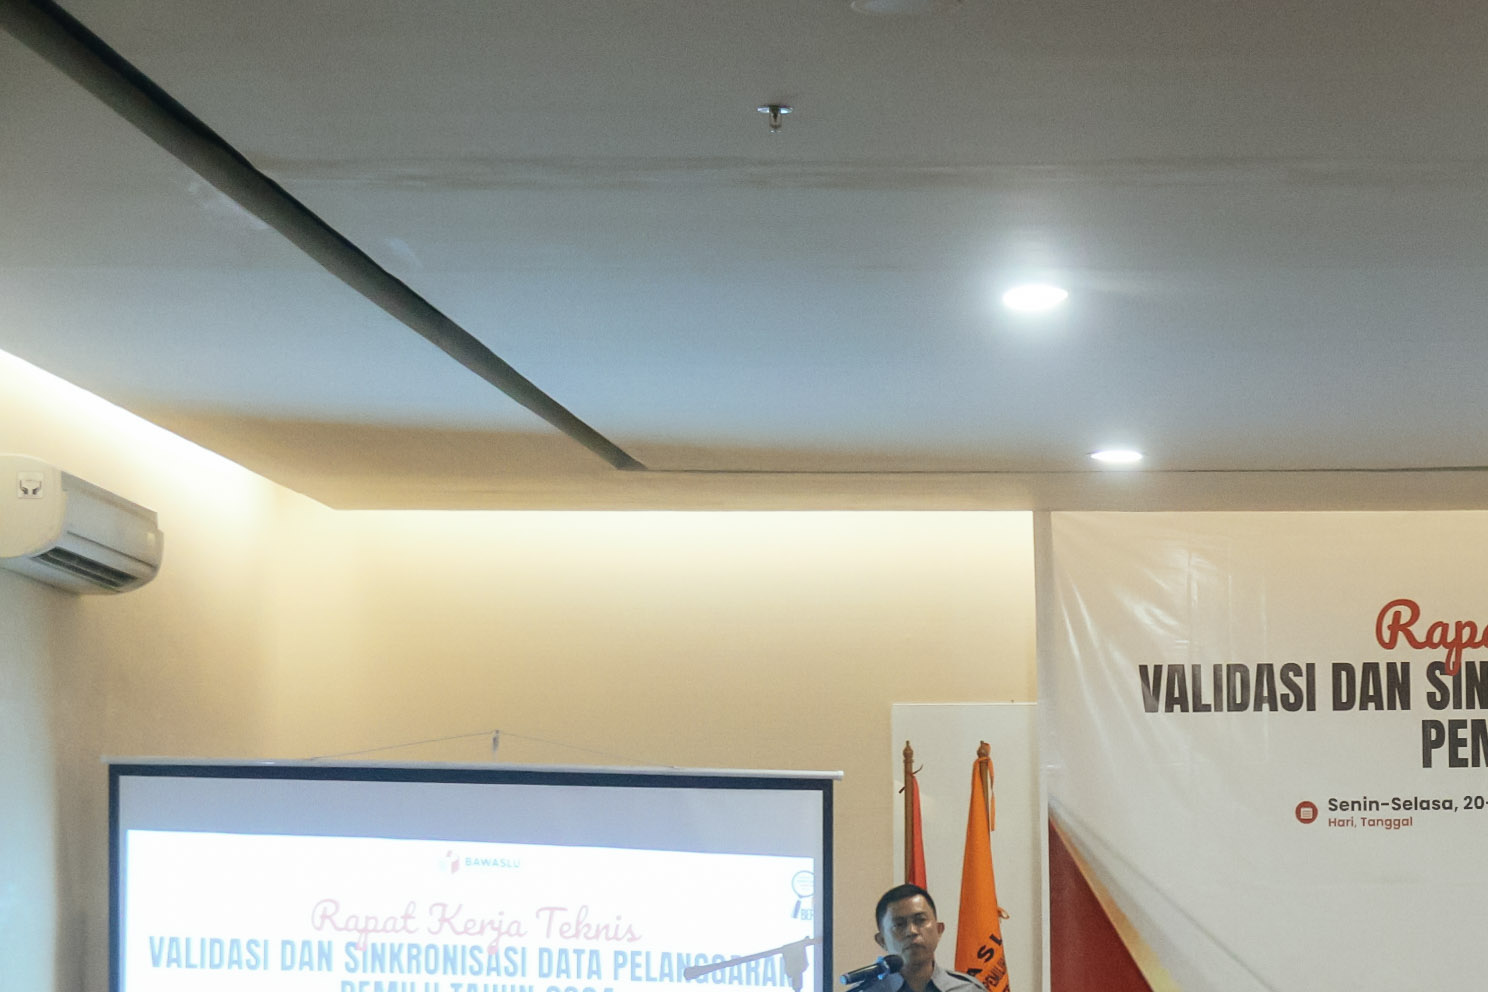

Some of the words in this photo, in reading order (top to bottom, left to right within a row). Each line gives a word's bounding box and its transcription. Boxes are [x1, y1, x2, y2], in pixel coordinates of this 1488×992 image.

[1138, 663, 1317, 713] VALIDASI
[1331, 661, 1411, 711] DAN
[1328, 797, 1458, 814] Senin-Selasa,
[1328, 817, 1358, 829] Hari,
[1360, 817, 1414, 831] Tanggal
[311, 898, 420, 951] Rapat
[427, 902, 528, 956] Kerja
[535, 905, 642, 944] Teknis
[149, 936, 270, 970] VALIDASI
[280, 939, 333, 972] DAN
[344, 941, 527, 978] SINKRONISASI
[538, 947, 602, 980] DATA
